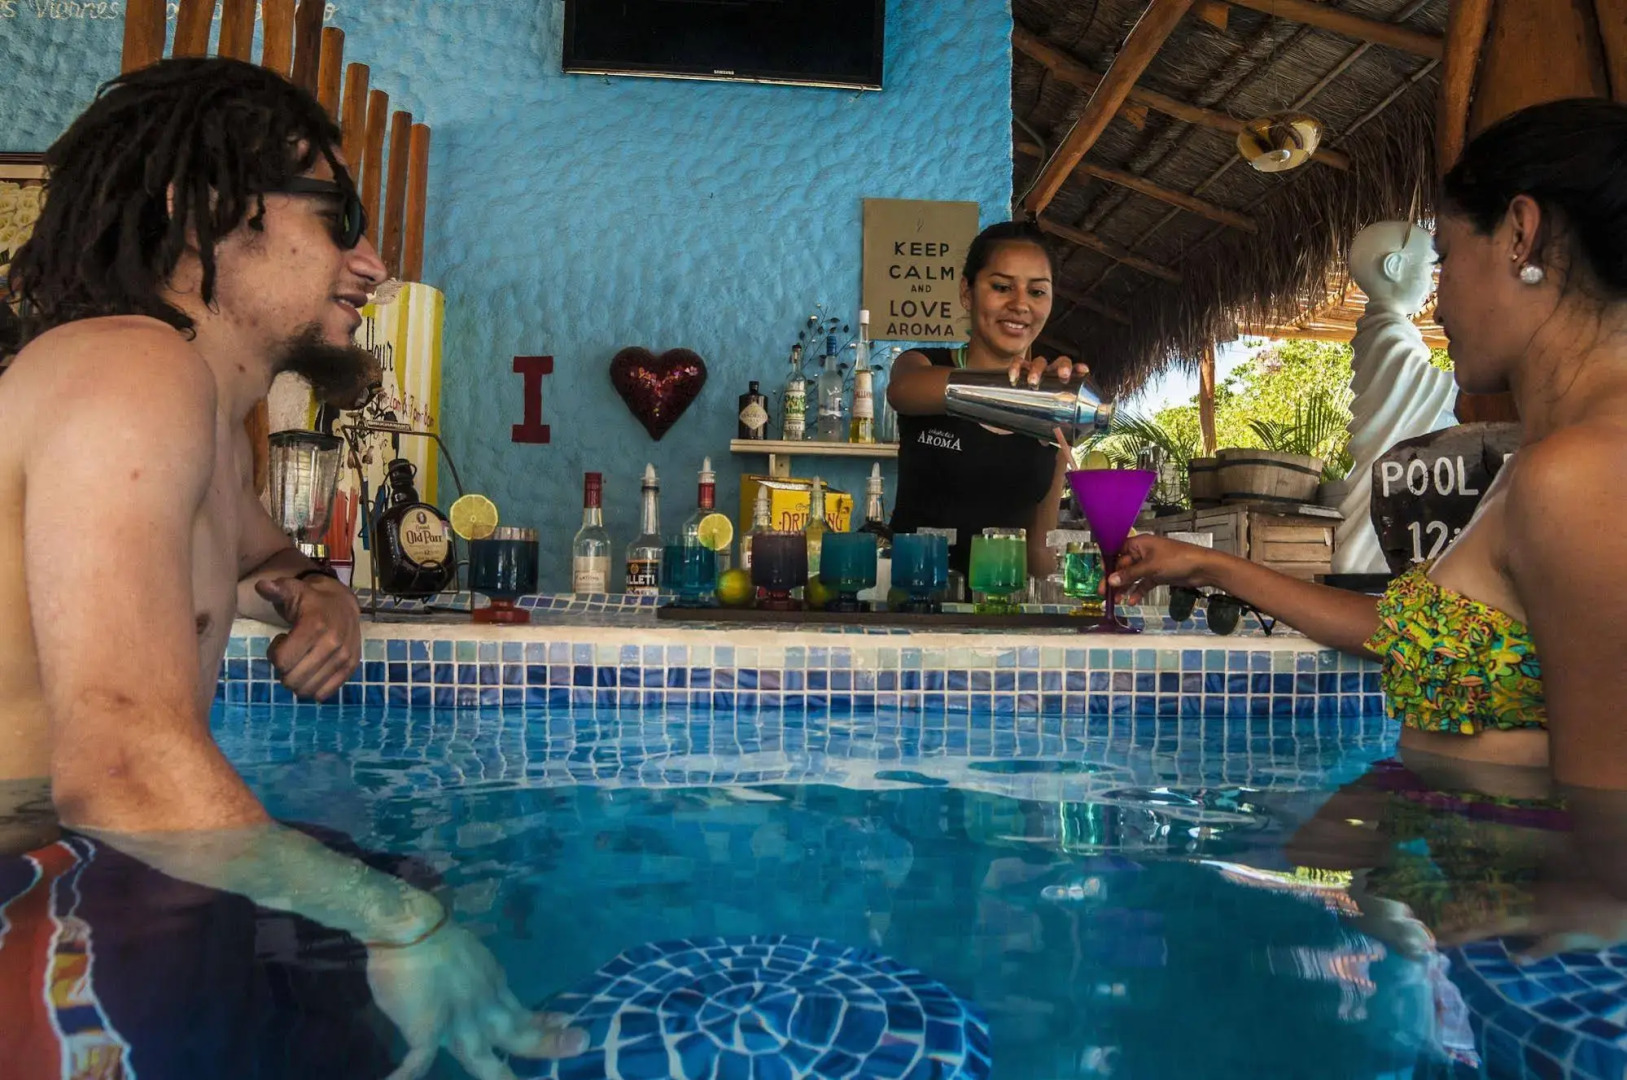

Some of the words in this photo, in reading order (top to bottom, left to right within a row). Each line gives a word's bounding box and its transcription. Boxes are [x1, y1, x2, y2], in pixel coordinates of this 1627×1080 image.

[894, 241, 950, 257] KEEP
[888, 264, 955, 281] CALM
[910, 284, 932, 293] AND
[889, 299, 952, 319] LOVE
[886, 322, 955, 337] AROMA
[917, 430, 963, 451] AROMA
[1381, 455, 1480, 498] POOL
[781, 510, 844, 533] DRING
[406, 530, 423, 544] Old
[423, 530, 442, 544] Parr
